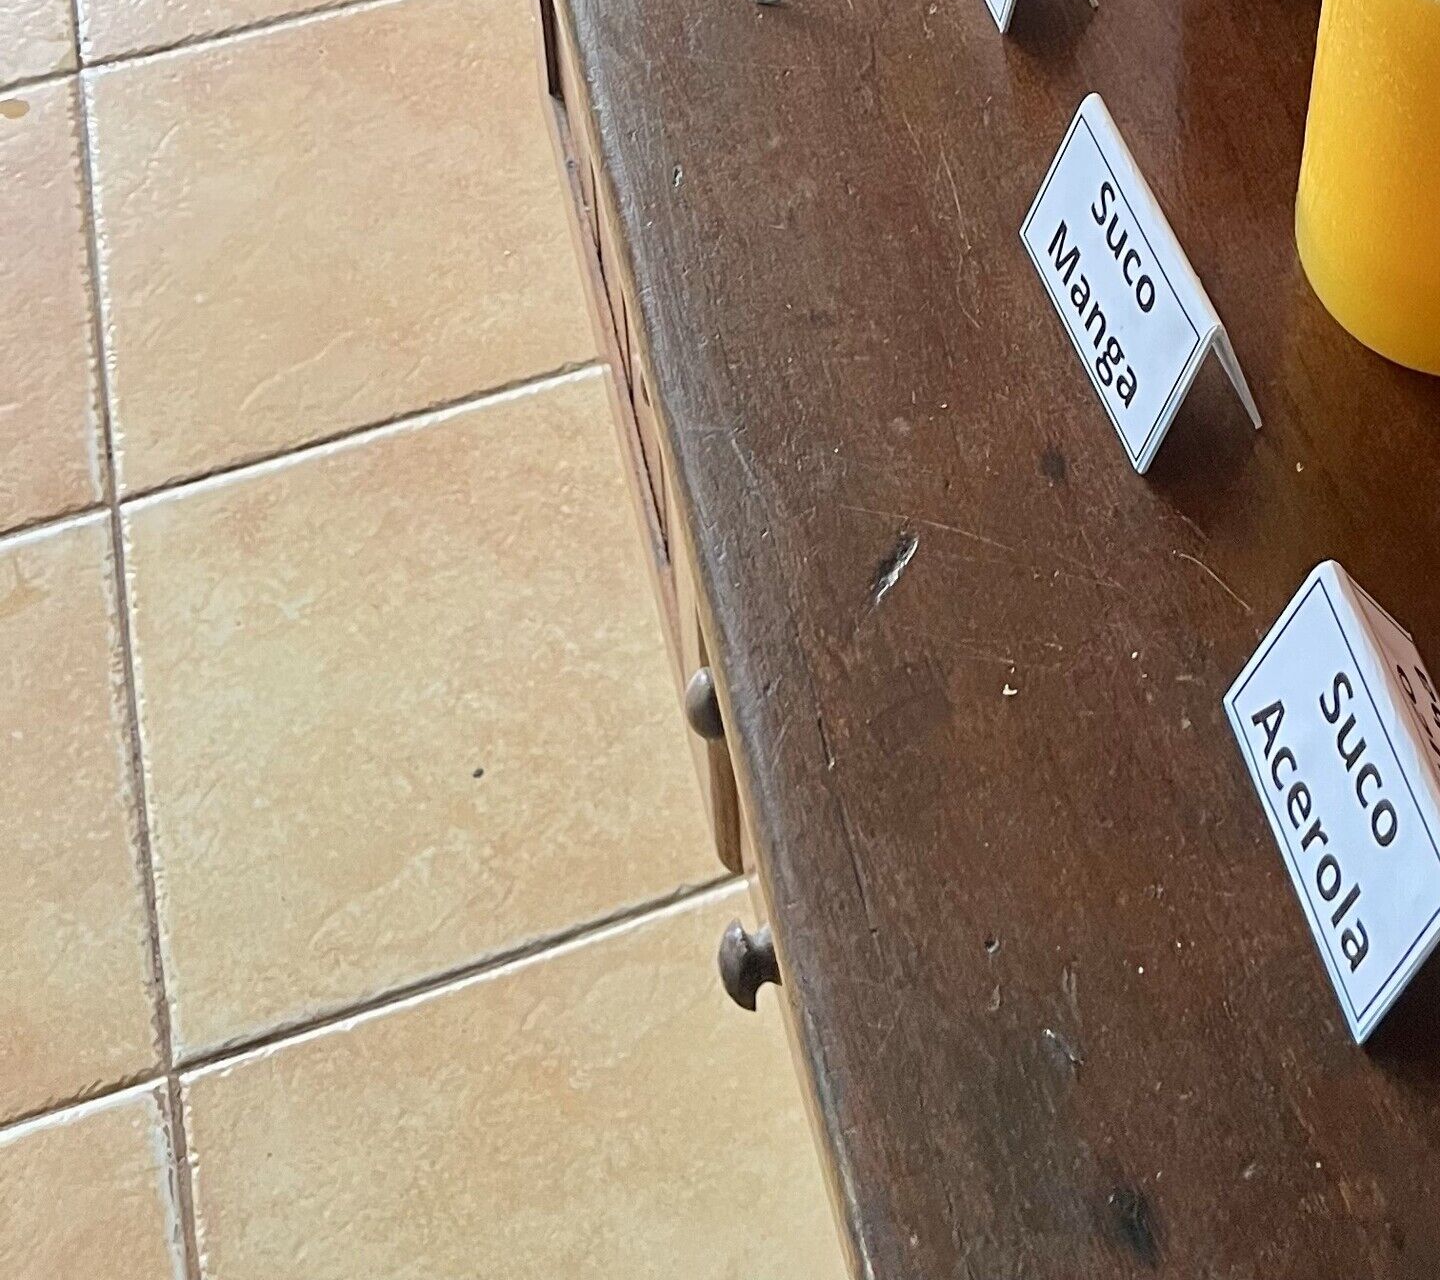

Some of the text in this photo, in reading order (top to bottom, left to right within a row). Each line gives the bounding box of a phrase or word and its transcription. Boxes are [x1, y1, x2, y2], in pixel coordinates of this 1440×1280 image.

[1047, 219, 1139, 410] Manga
[1090, 181, 1156, 314] Suco
[1251, 698, 1369, 973] Acerola
[1318, 670, 1399, 848] Suco
